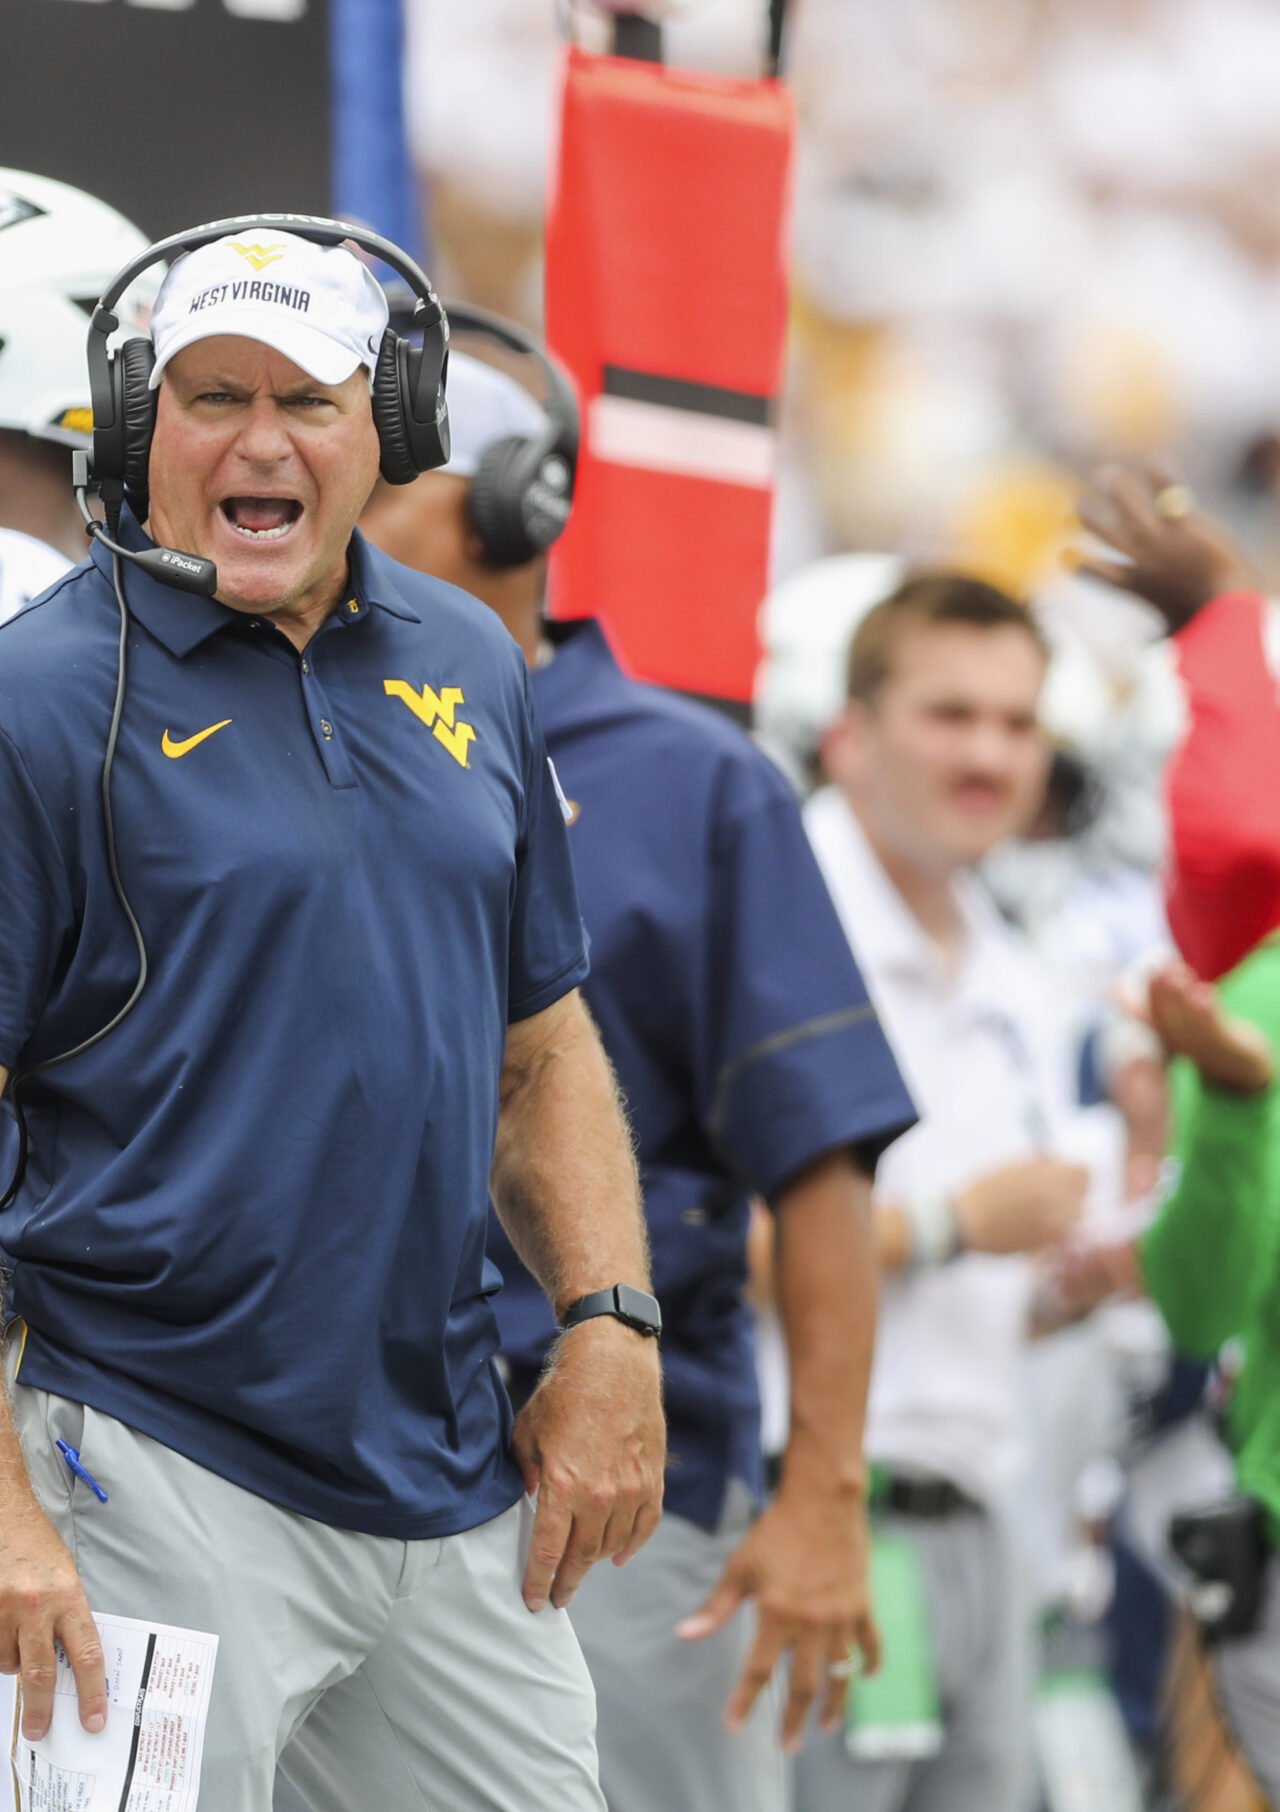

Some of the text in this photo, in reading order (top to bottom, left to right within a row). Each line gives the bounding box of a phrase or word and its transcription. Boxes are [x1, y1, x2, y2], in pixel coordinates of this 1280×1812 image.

[189, 281, 311, 314] WEST VIRGINIA
[170, 556, 202, 573] iPacket
